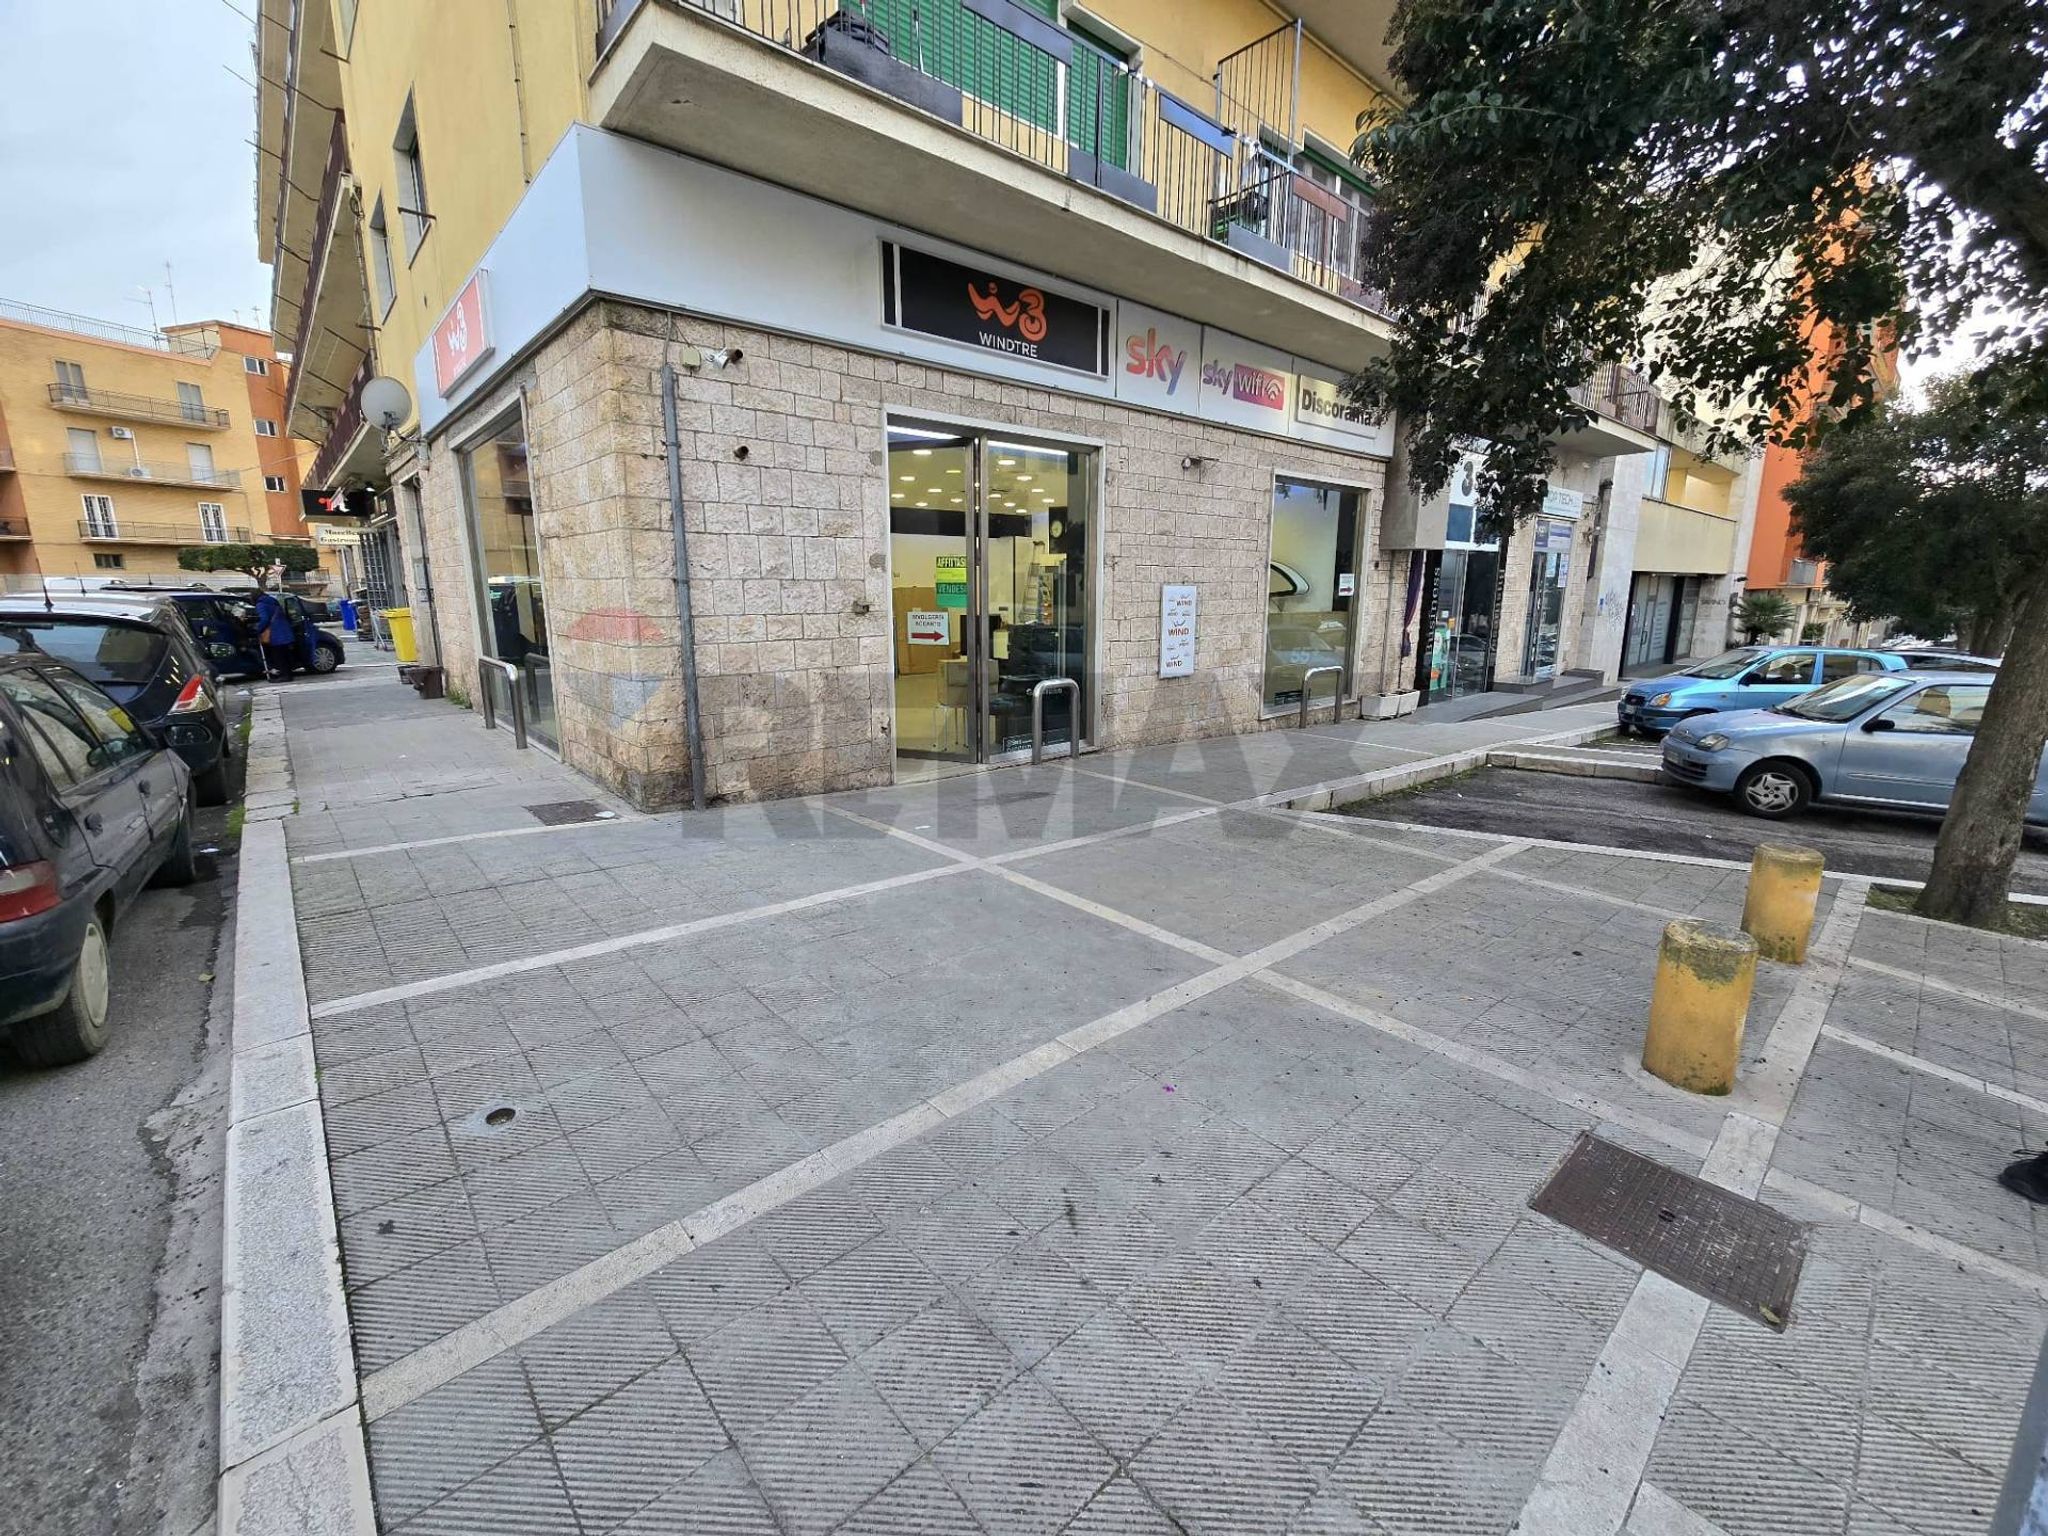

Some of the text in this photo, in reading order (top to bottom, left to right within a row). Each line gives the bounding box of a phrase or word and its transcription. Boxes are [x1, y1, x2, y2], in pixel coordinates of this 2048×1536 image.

[979, 330, 1038, 357] WINDTRE
[1126, 328, 1188, 395] sky
[1203, 360, 1265, 398] sky wifi
[1168, 628, 1190, 637] WIND
[1166, 660, 1183, 668] WIND
